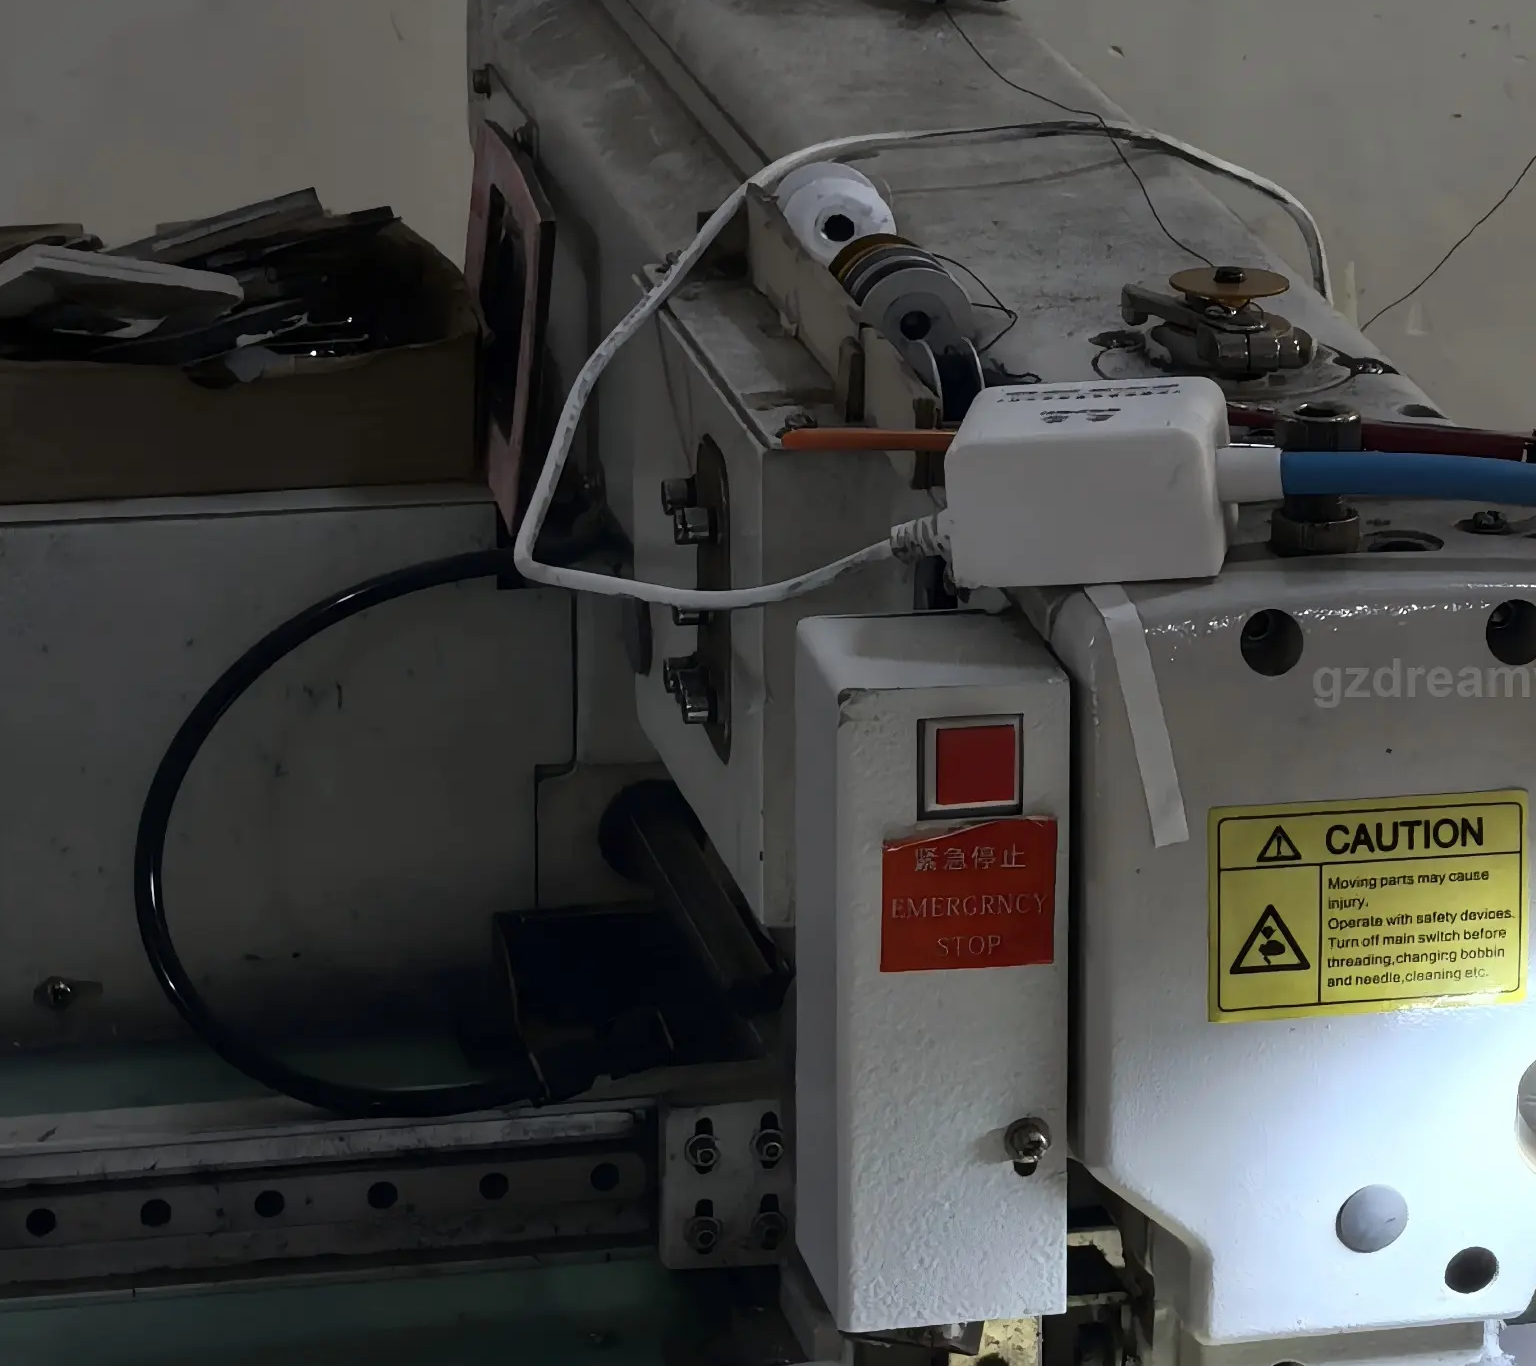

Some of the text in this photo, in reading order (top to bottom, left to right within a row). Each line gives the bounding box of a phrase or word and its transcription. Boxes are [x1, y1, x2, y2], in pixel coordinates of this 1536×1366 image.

[1325, 816, 1484, 855] CAUTION
[1327, 876, 1377, 890] Moving
[1380, 872, 1415, 888] parts
[1417, 871, 1446, 886] may
[1327, 916, 1383, 931] Operate
[1386, 912, 1413, 927] with
[1416, 910, 1458, 926] safety
[936, 935, 1002, 958] STOP
[1328, 928, 1507, 951] Turn off main switch before
[1460, 947, 1506, 960] bobbin
[1327, 976, 1353, 989] and
